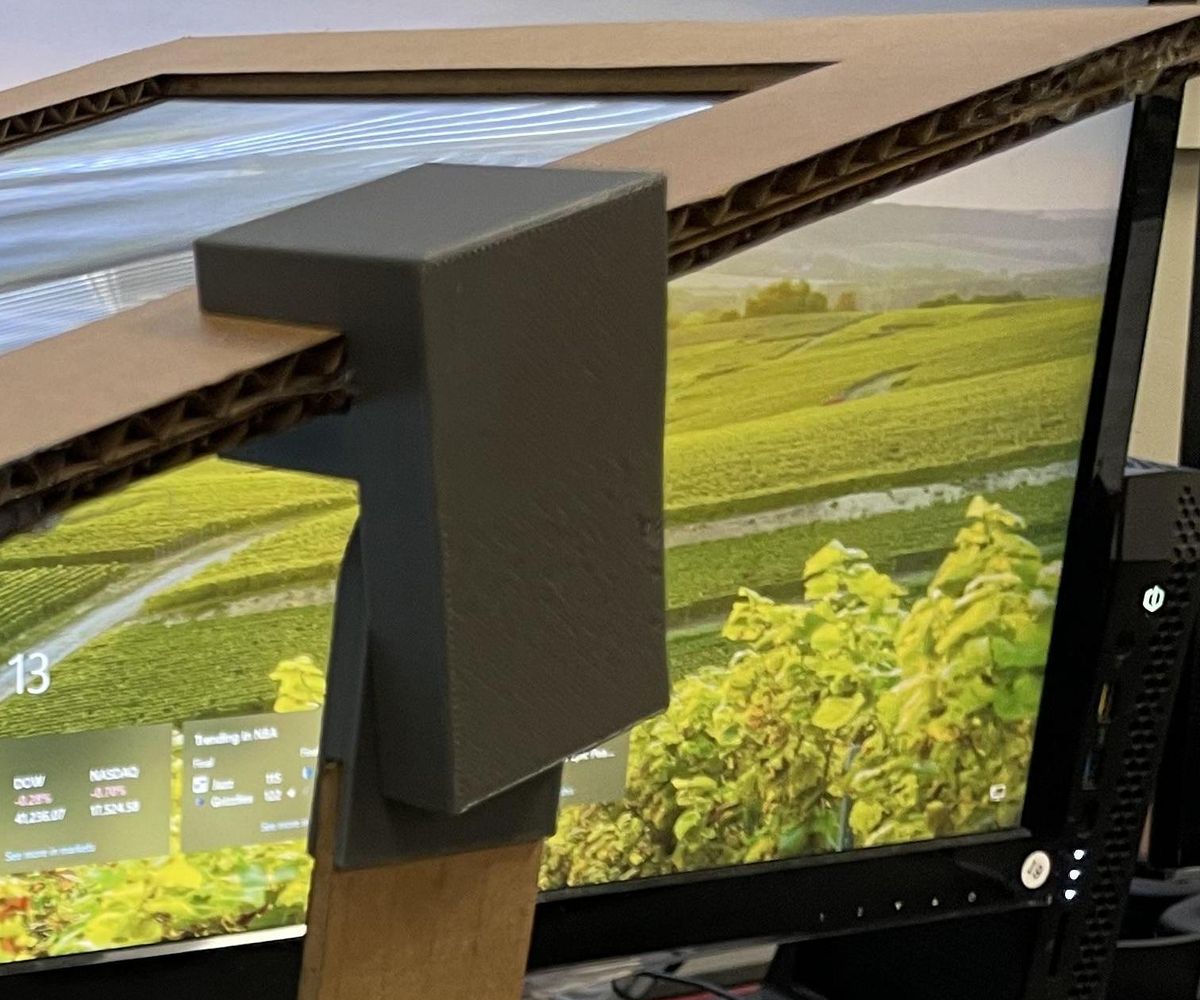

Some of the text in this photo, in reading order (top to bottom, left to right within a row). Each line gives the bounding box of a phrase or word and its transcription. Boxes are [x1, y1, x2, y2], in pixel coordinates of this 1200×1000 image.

[7, 651, 51, 696] 13
[12, 774, 46, 790] DOW
[89, 766, 140, 782] NASDAQ
